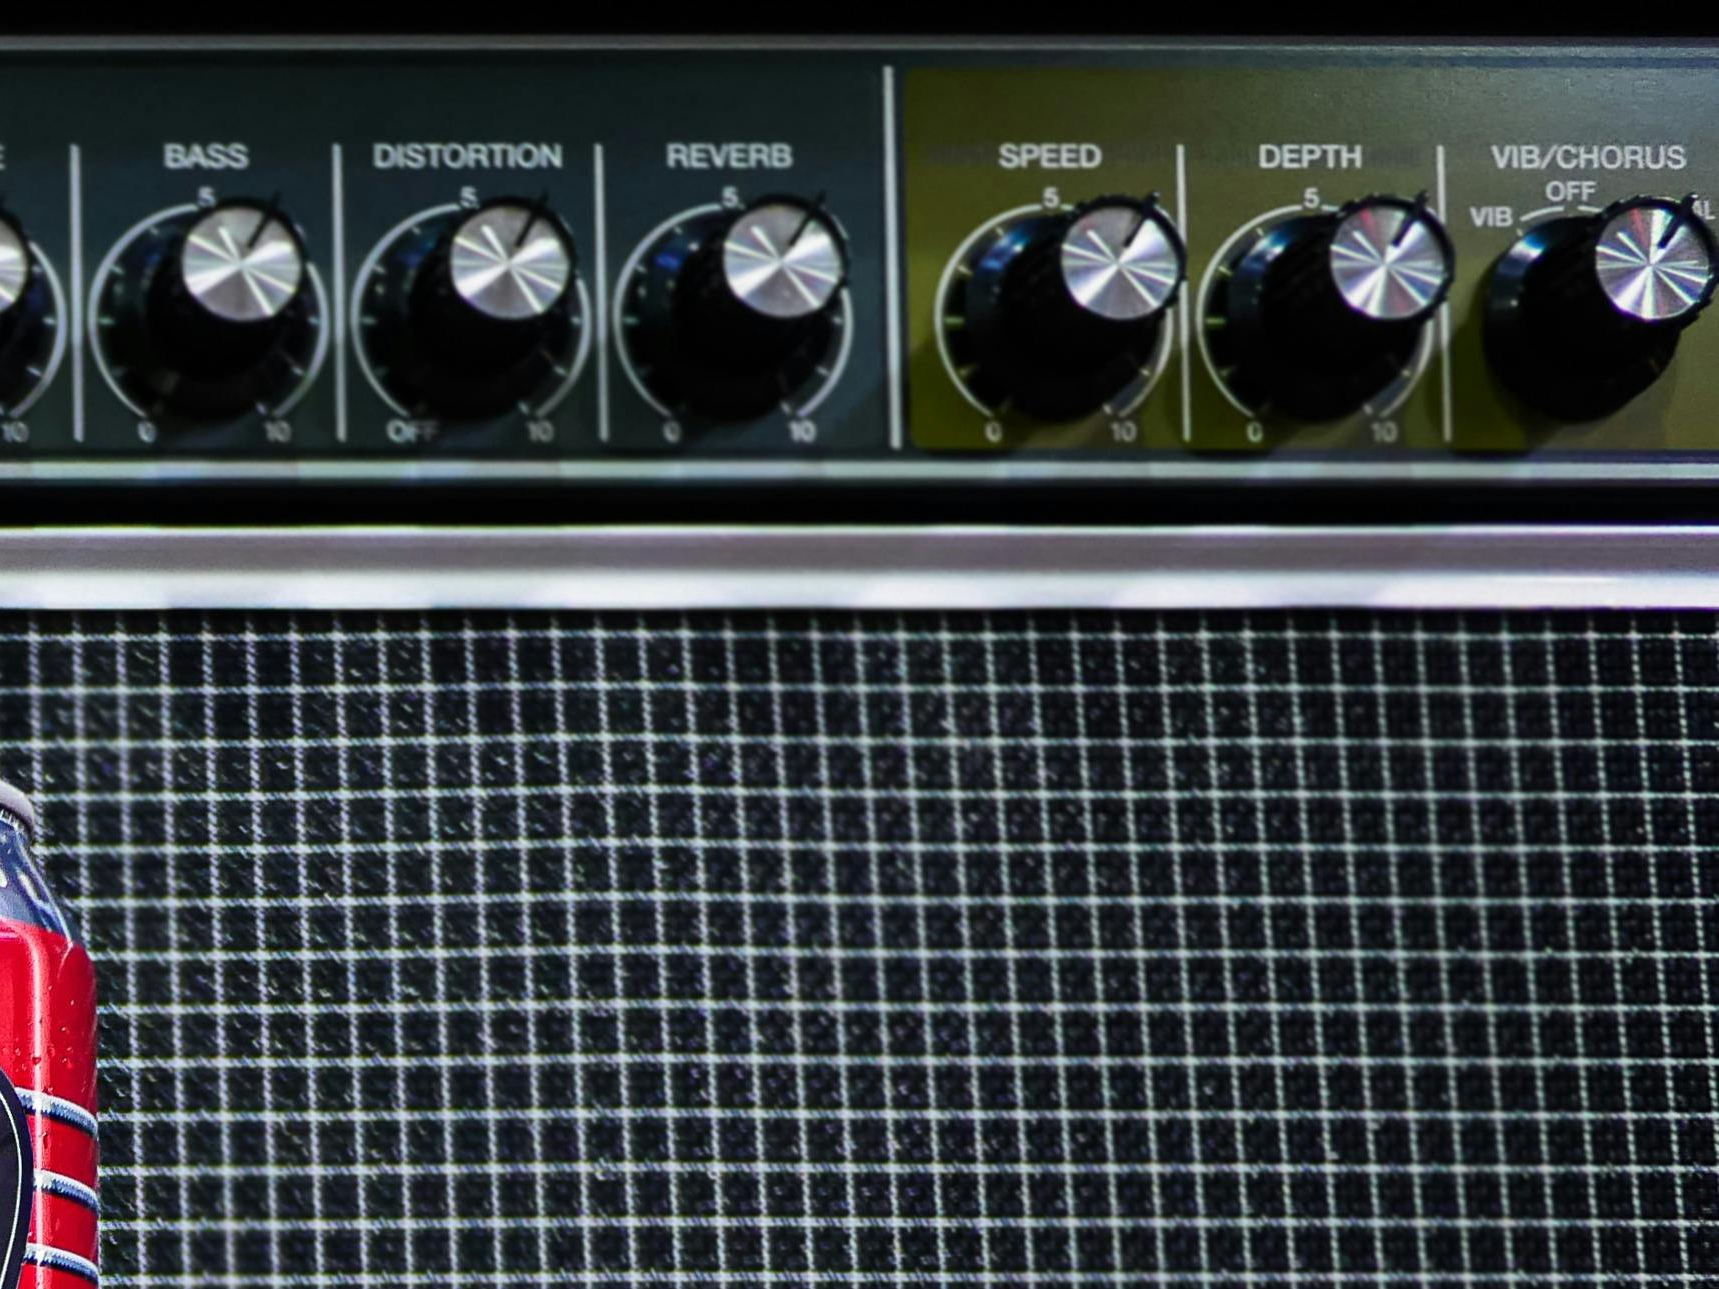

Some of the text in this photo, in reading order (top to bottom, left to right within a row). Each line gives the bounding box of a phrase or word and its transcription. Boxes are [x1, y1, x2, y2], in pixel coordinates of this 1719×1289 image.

[163, 143, 249, 170] BASS
[373, 143, 562, 170] DISTORTION
[666, 143, 793, 169] REVERB
[998, 143, 1102, 169] SPEED
[1259, 144, 1362, 169] DEPTH
[1491, 144, 1687, 170] VIB/CHORUS
[198, 187, 216, 206] 5
[460, 186, 479, 209] 5
[721, 187, 738, 208] 5
[1043, 187, 1060, 209] 5
[1303, 188, 1319, 209] 5
[1546, 181, 1596, 202] OFF
[1470, 207, 1513, 228] VIB
[1, 423, 28, 443] 10
[265, 422, 291, 442] 10
[387, 422, 439, 443] OFF
[527, 422, 553, 442] 10
[664, 421, 681, 443] 0
[788, 421, 816, 443] 10
[985, 421, 1002, 443] 0
[1111, 421, 1137, 443] 10
[1246, 421, 1263, 443] 0
[1372, 421, 1398, 443] 10
